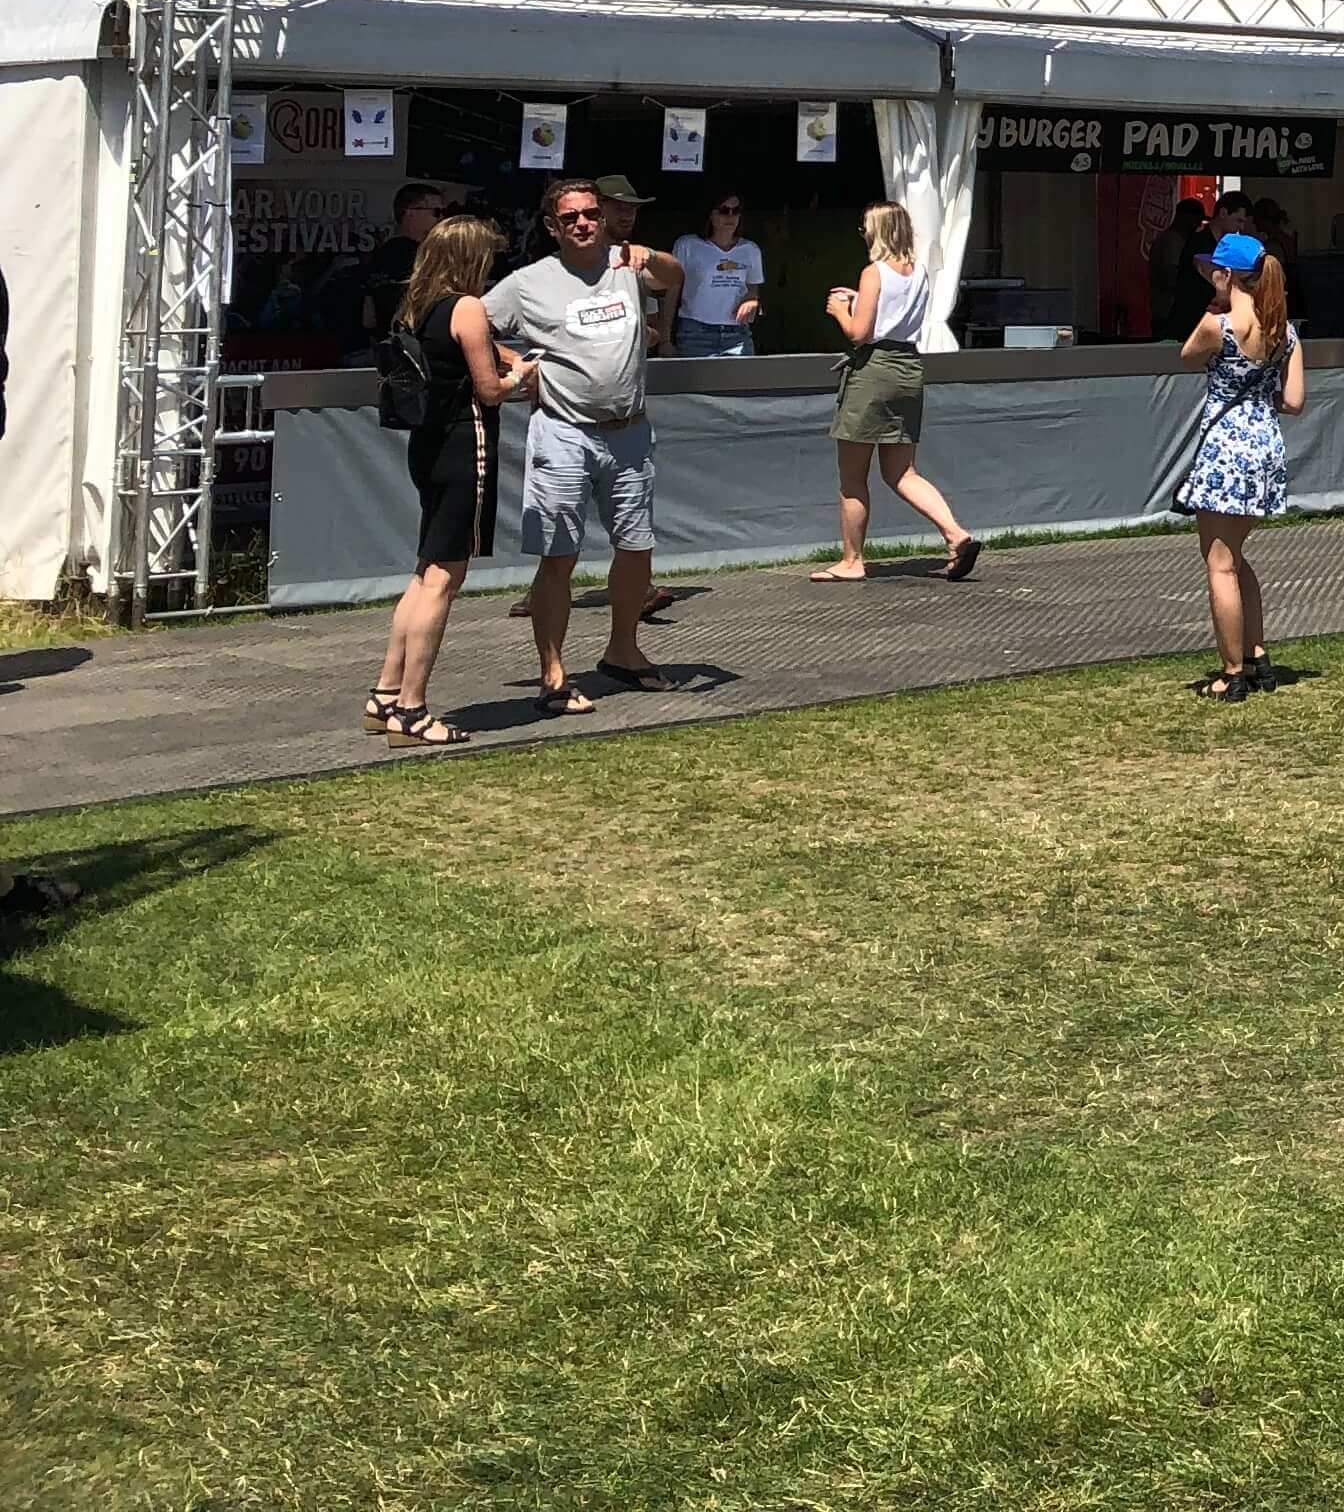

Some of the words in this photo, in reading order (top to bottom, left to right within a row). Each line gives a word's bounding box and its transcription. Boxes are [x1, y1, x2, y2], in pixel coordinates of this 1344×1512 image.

[1000, 117, 1102, 149] BURGER
[1122, 120, 1201, 157] PAD
[289, 189, 366, 219] VOOR
